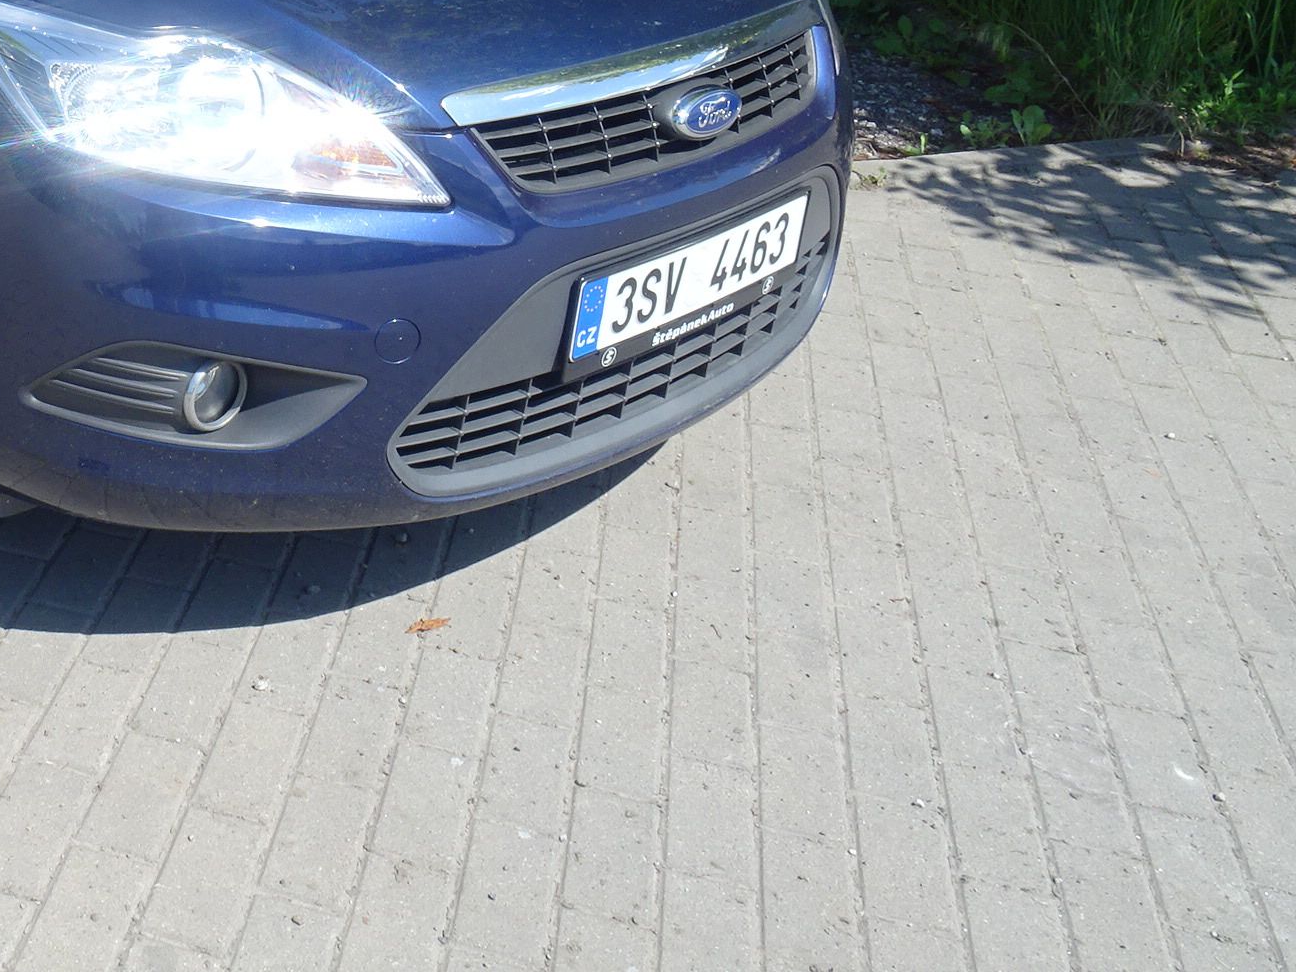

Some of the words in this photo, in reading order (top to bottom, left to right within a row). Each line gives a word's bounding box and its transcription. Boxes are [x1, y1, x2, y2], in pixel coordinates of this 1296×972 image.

[698, 96, 732, 128] Ford
[612, 256, 687, 334] 3SV
[710, 211, 790, 292] 4463
[575, 325, 598, 348] CZ
